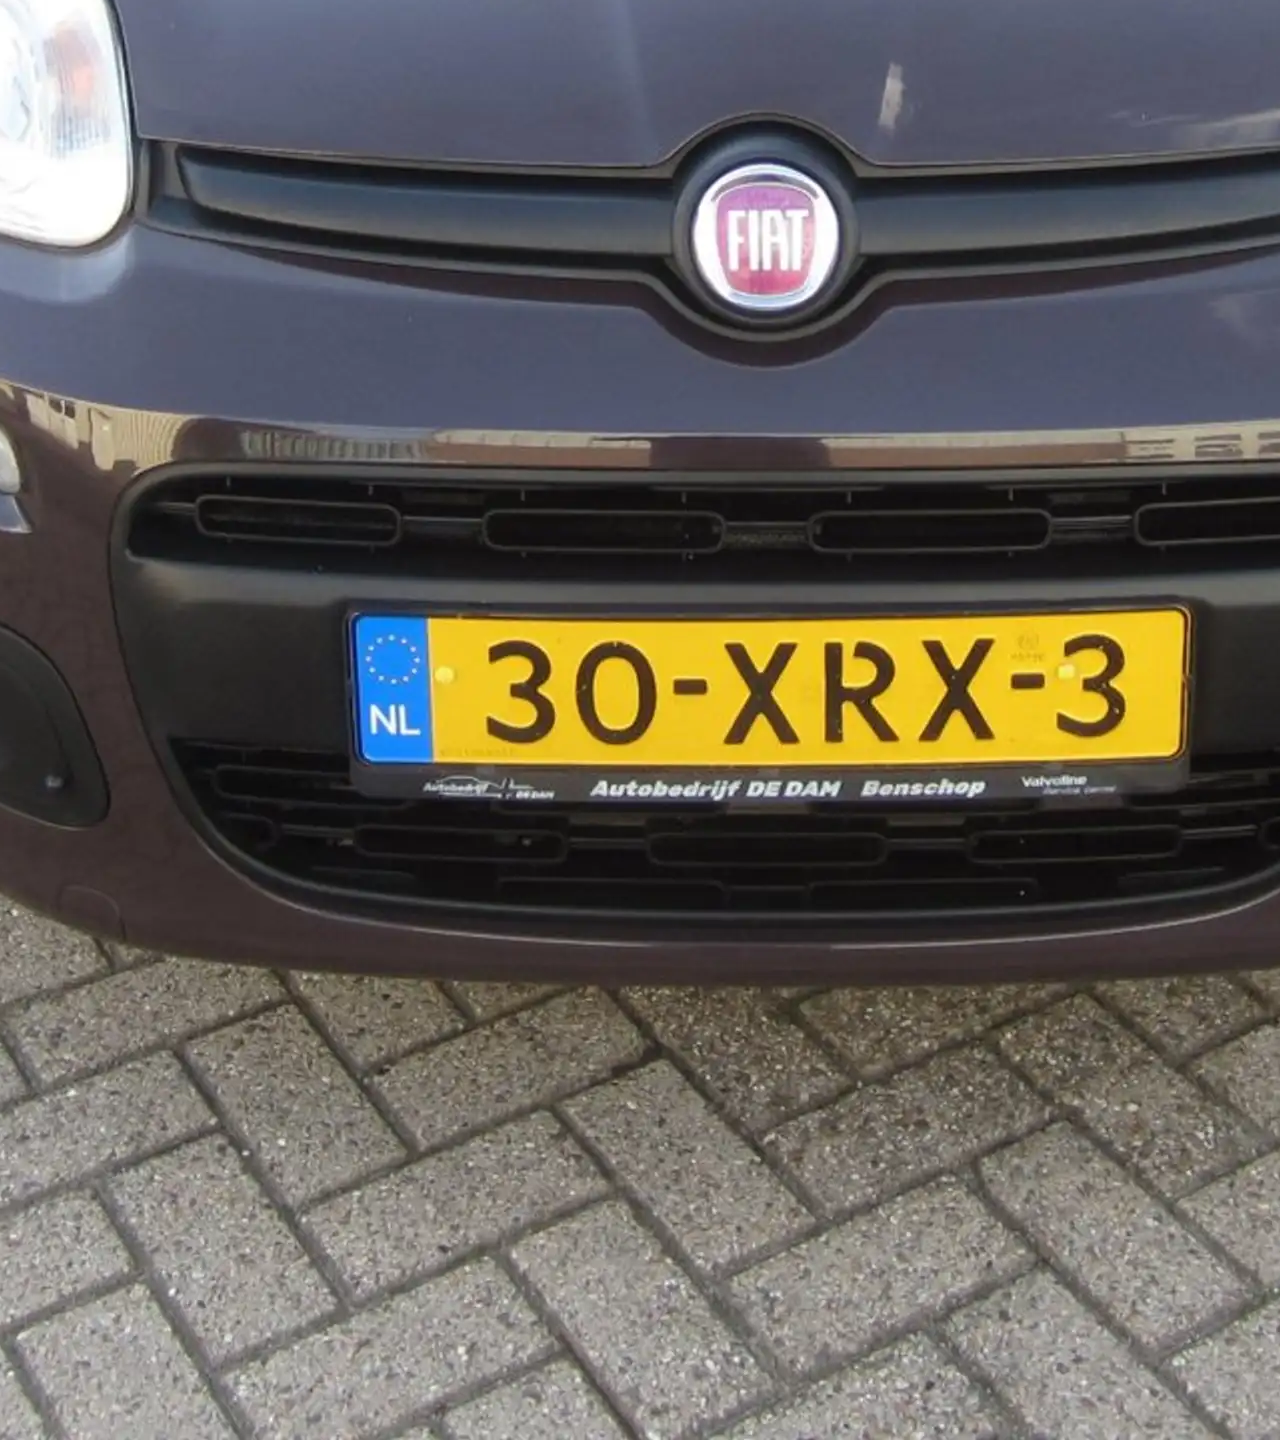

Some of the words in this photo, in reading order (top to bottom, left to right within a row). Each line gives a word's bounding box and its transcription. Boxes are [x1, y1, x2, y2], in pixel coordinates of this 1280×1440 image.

[726, 208, 810, 273] FIAT
[485, 633, 1127, 745] 30-XRX-3
[369, 703, 421, 736] NL
[589, 779, 742, 802] Autobedrijf
[746, 780, 783, 798] DE
[784, 779, 842, 798] DAM
[860, 777, 987, 799] Benschop
[1020, 774, 1088, 788] Valvoline
